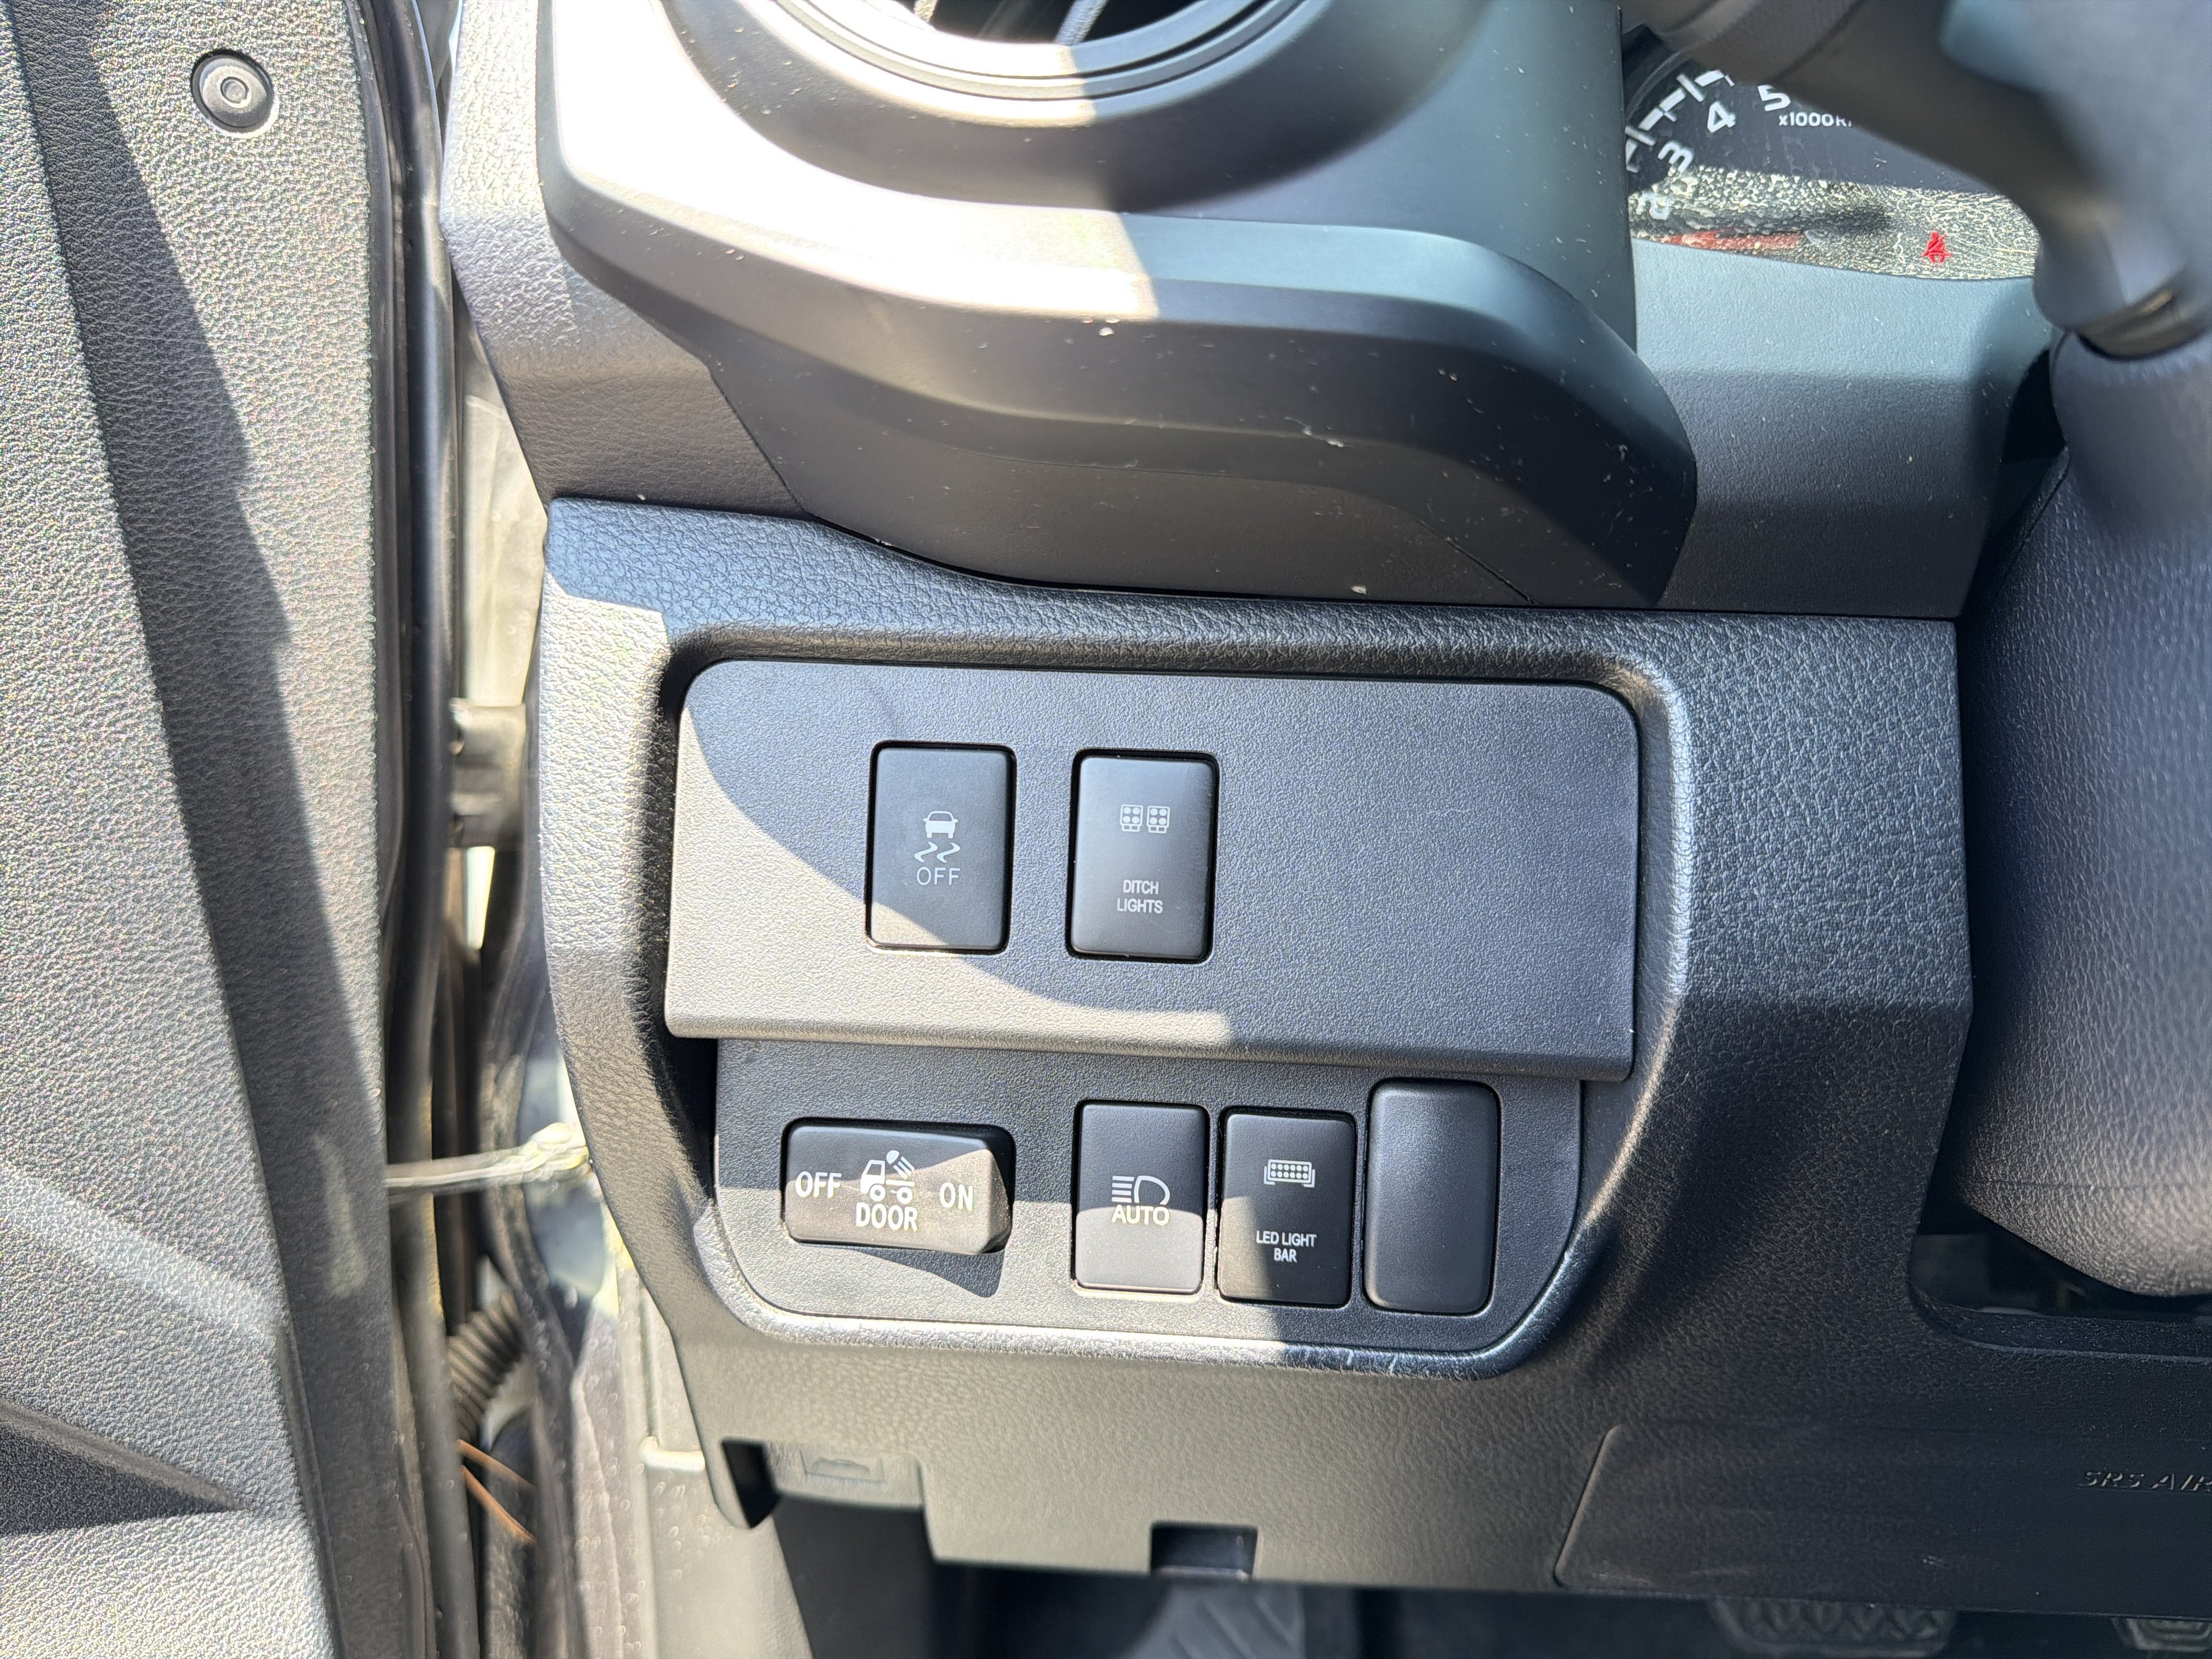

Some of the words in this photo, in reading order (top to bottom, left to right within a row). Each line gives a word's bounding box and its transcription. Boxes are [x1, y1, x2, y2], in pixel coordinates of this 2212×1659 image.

[1757, 84, 1791, 112] 5
[1707, 100, 1736, 134] 4
[1778, 111, 1852, 127] x1000R
[1657, 140, 1695, 173] 3
[916, 866, 961, 886] OFF
[1122, 879, 1159, 895] DITCH
[1116, 898, 1163, 915] LIGHTS
[795, 1171, 842, 1198] OFF
[940, 1182, 974, 1211] ON
[856, 1202, 918, 1232] DOOR
[1111, 1204, 1170, 1226] AUTO
[1256, 1230, 1279, 1245] LED
[1282, 1232, 1317, 1248] LIGHT
[1273, 1248, 1297, 1263] BAR
[2081, 1471, 2145, 1488] SRS
